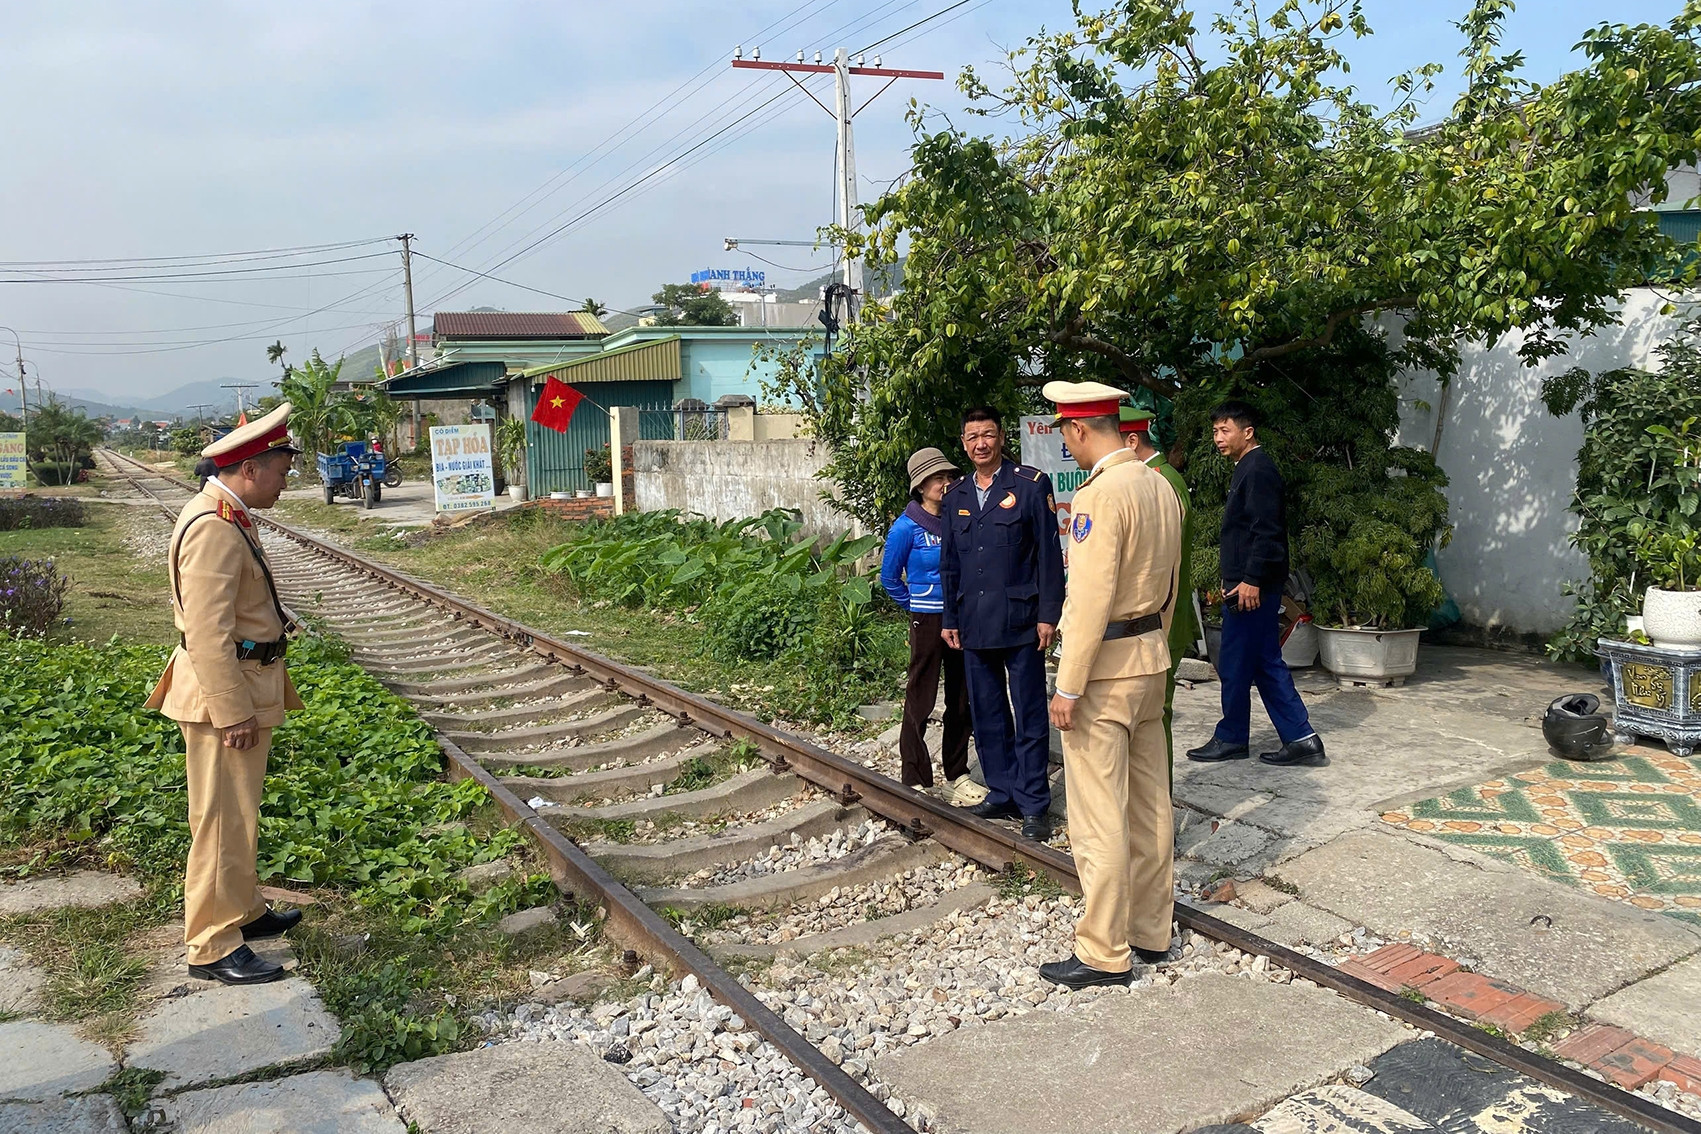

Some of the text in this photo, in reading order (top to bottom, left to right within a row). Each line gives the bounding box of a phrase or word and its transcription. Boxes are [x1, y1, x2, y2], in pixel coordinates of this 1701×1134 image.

[733, 266, 765, 281] THẮNG
[1027, 421, 1053, 435] Yên
[435, 432, 489, 460] TẠP HÓA
